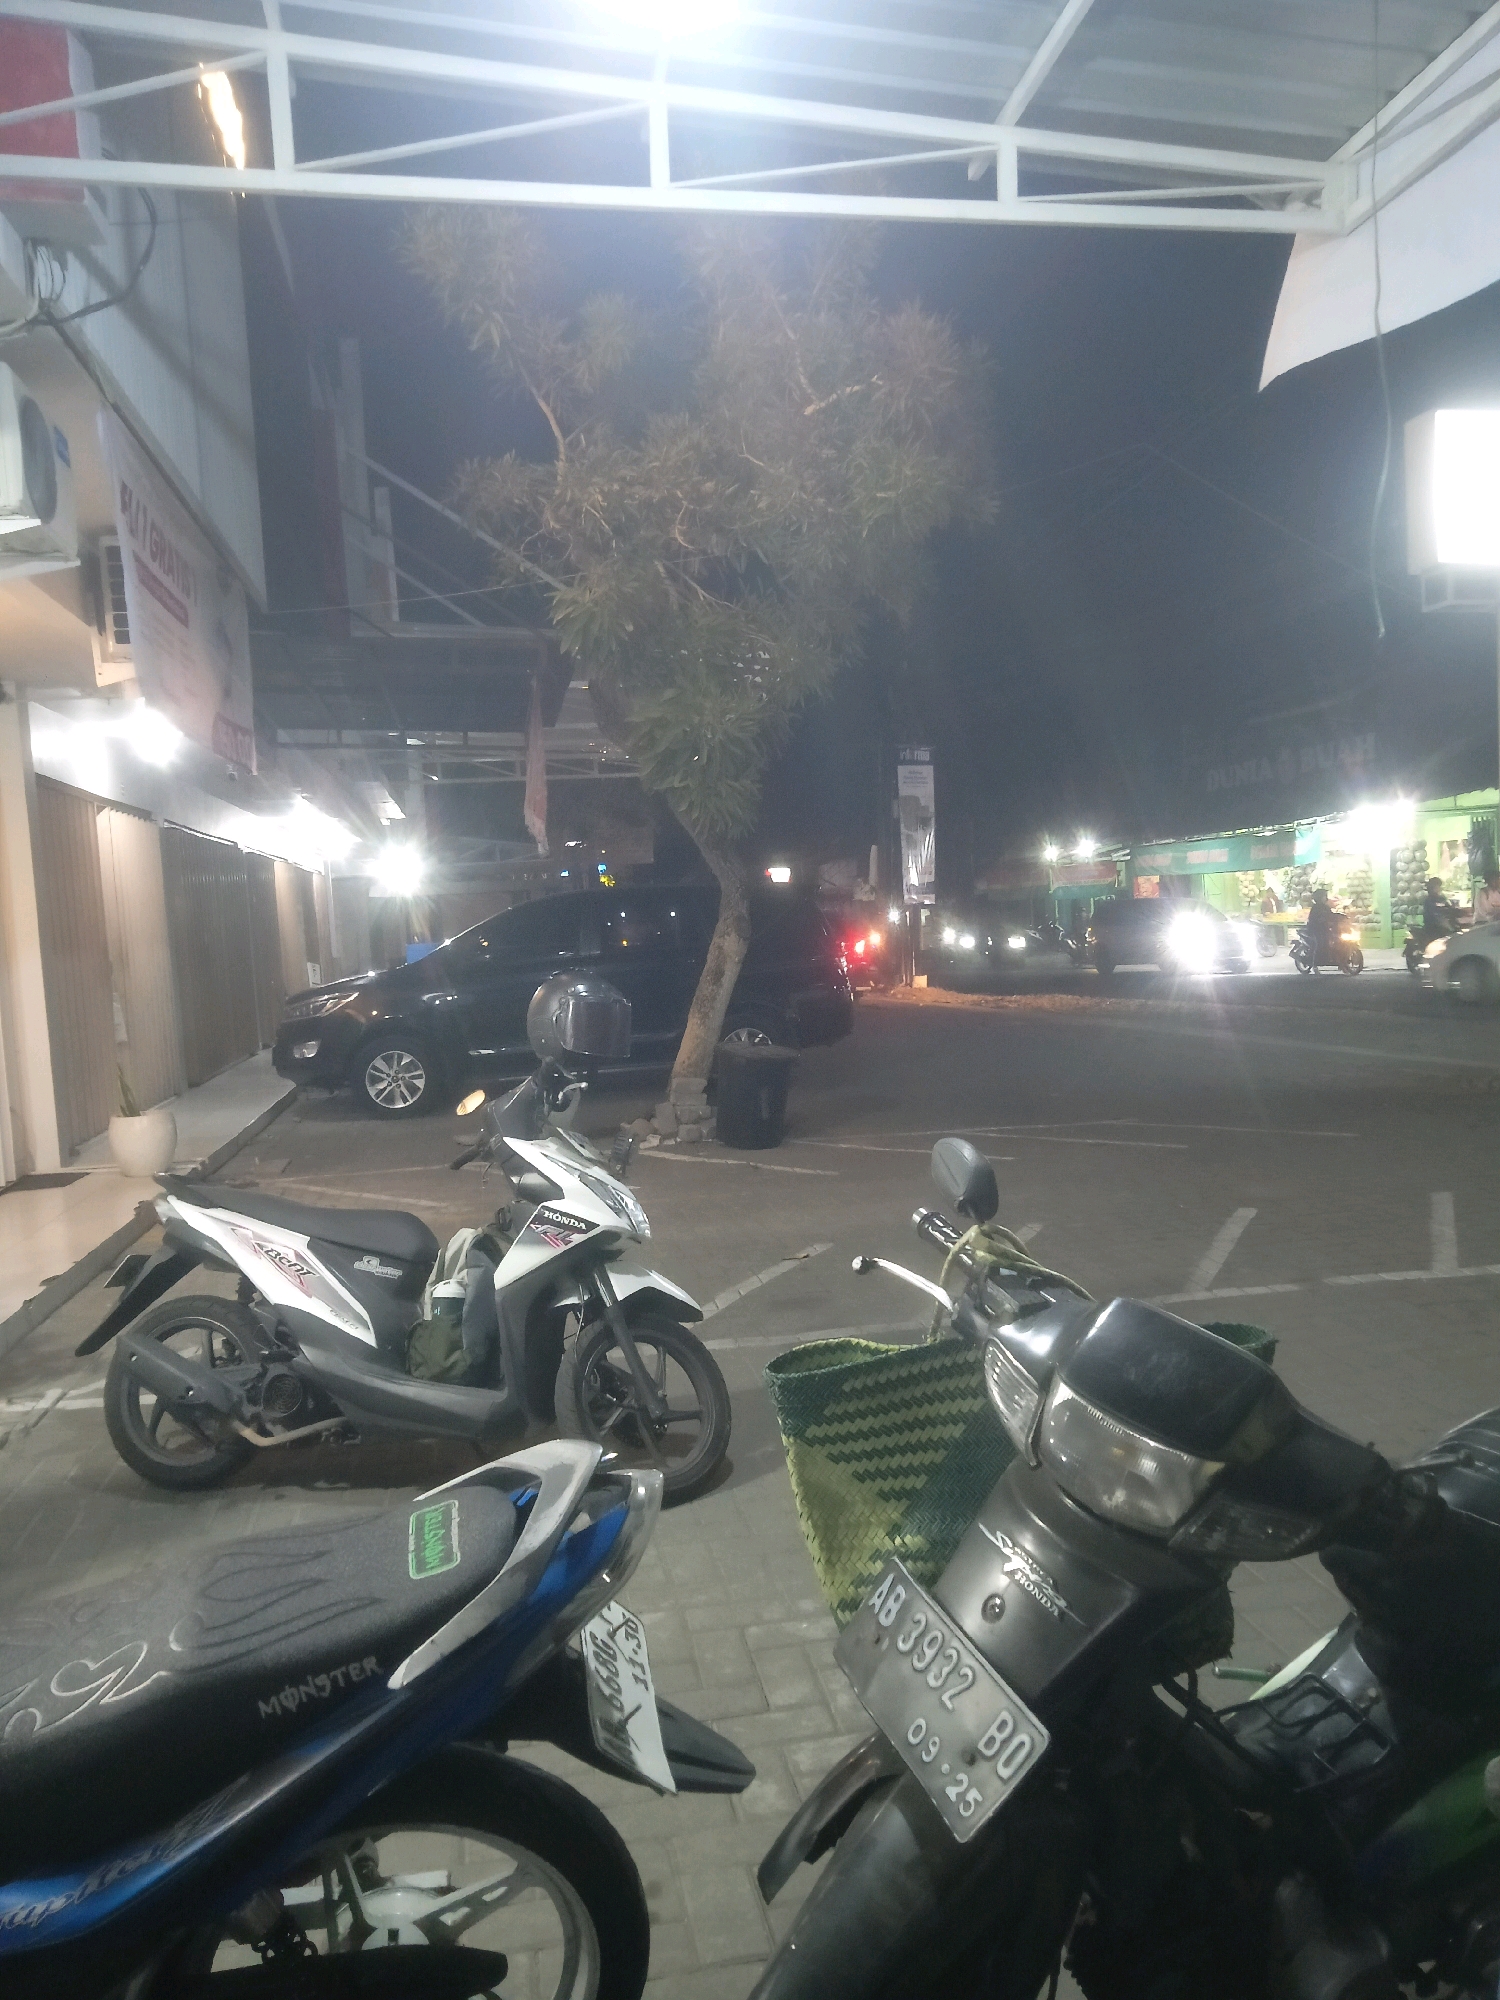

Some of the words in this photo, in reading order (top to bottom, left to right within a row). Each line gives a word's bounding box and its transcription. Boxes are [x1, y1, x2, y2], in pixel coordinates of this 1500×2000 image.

[543, 1210, 587, 1231] HONDA
[1014, 1570, 1059, 1617] HONDA
[868, 1573, 906, 1627] AB
[897, 1611, 975, 1711] 3932
[258, 1655, 383, 1720] MONSTER
